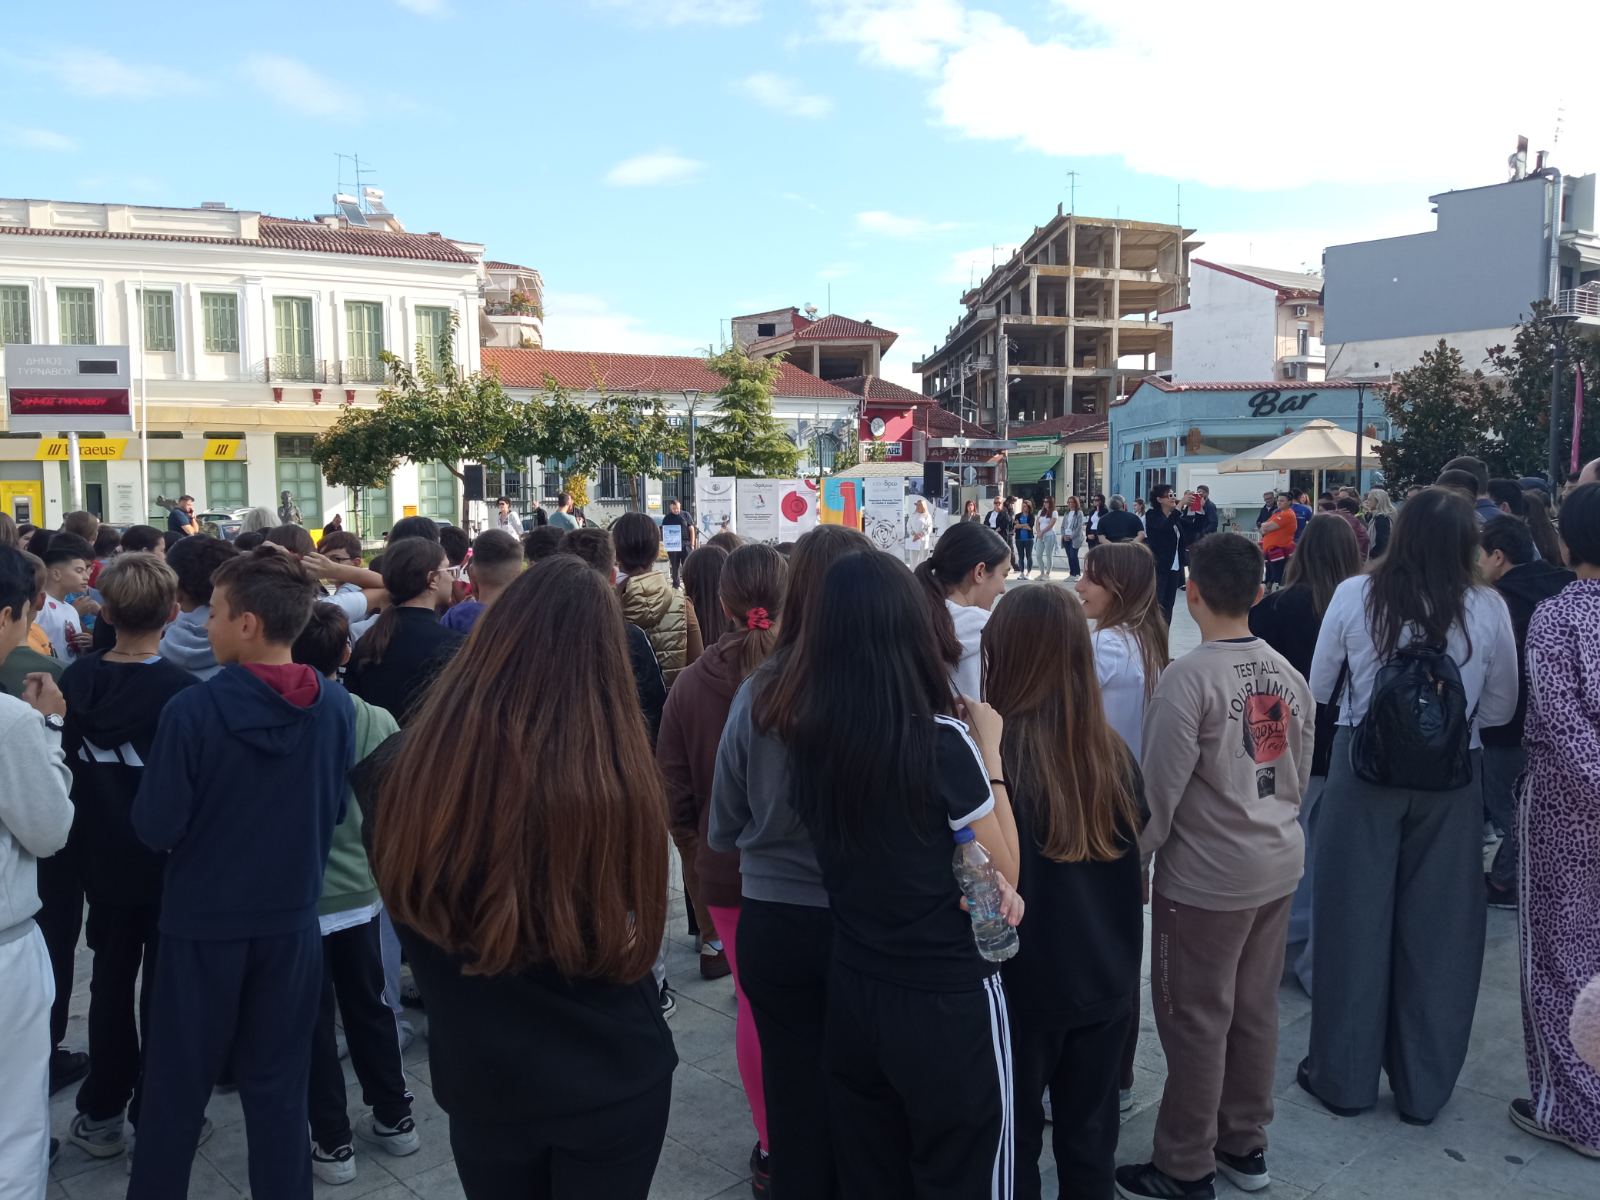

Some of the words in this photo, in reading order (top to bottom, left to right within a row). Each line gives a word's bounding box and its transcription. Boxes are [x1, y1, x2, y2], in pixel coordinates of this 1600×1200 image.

[26, 357, 63, 366] ΔΗΜΟΣ
[17, 367, 72, 376] ΤΥΡΝΑΒΟΥ
[1248, 388, 1318, 417] Bar
[1233, 661, 1257, 679] TEST
[1260, 660, 1280, 675] ALL
[1228, 682, 1254, 722] YOUR
[1255, 678, 1300, 717] LIMITS
